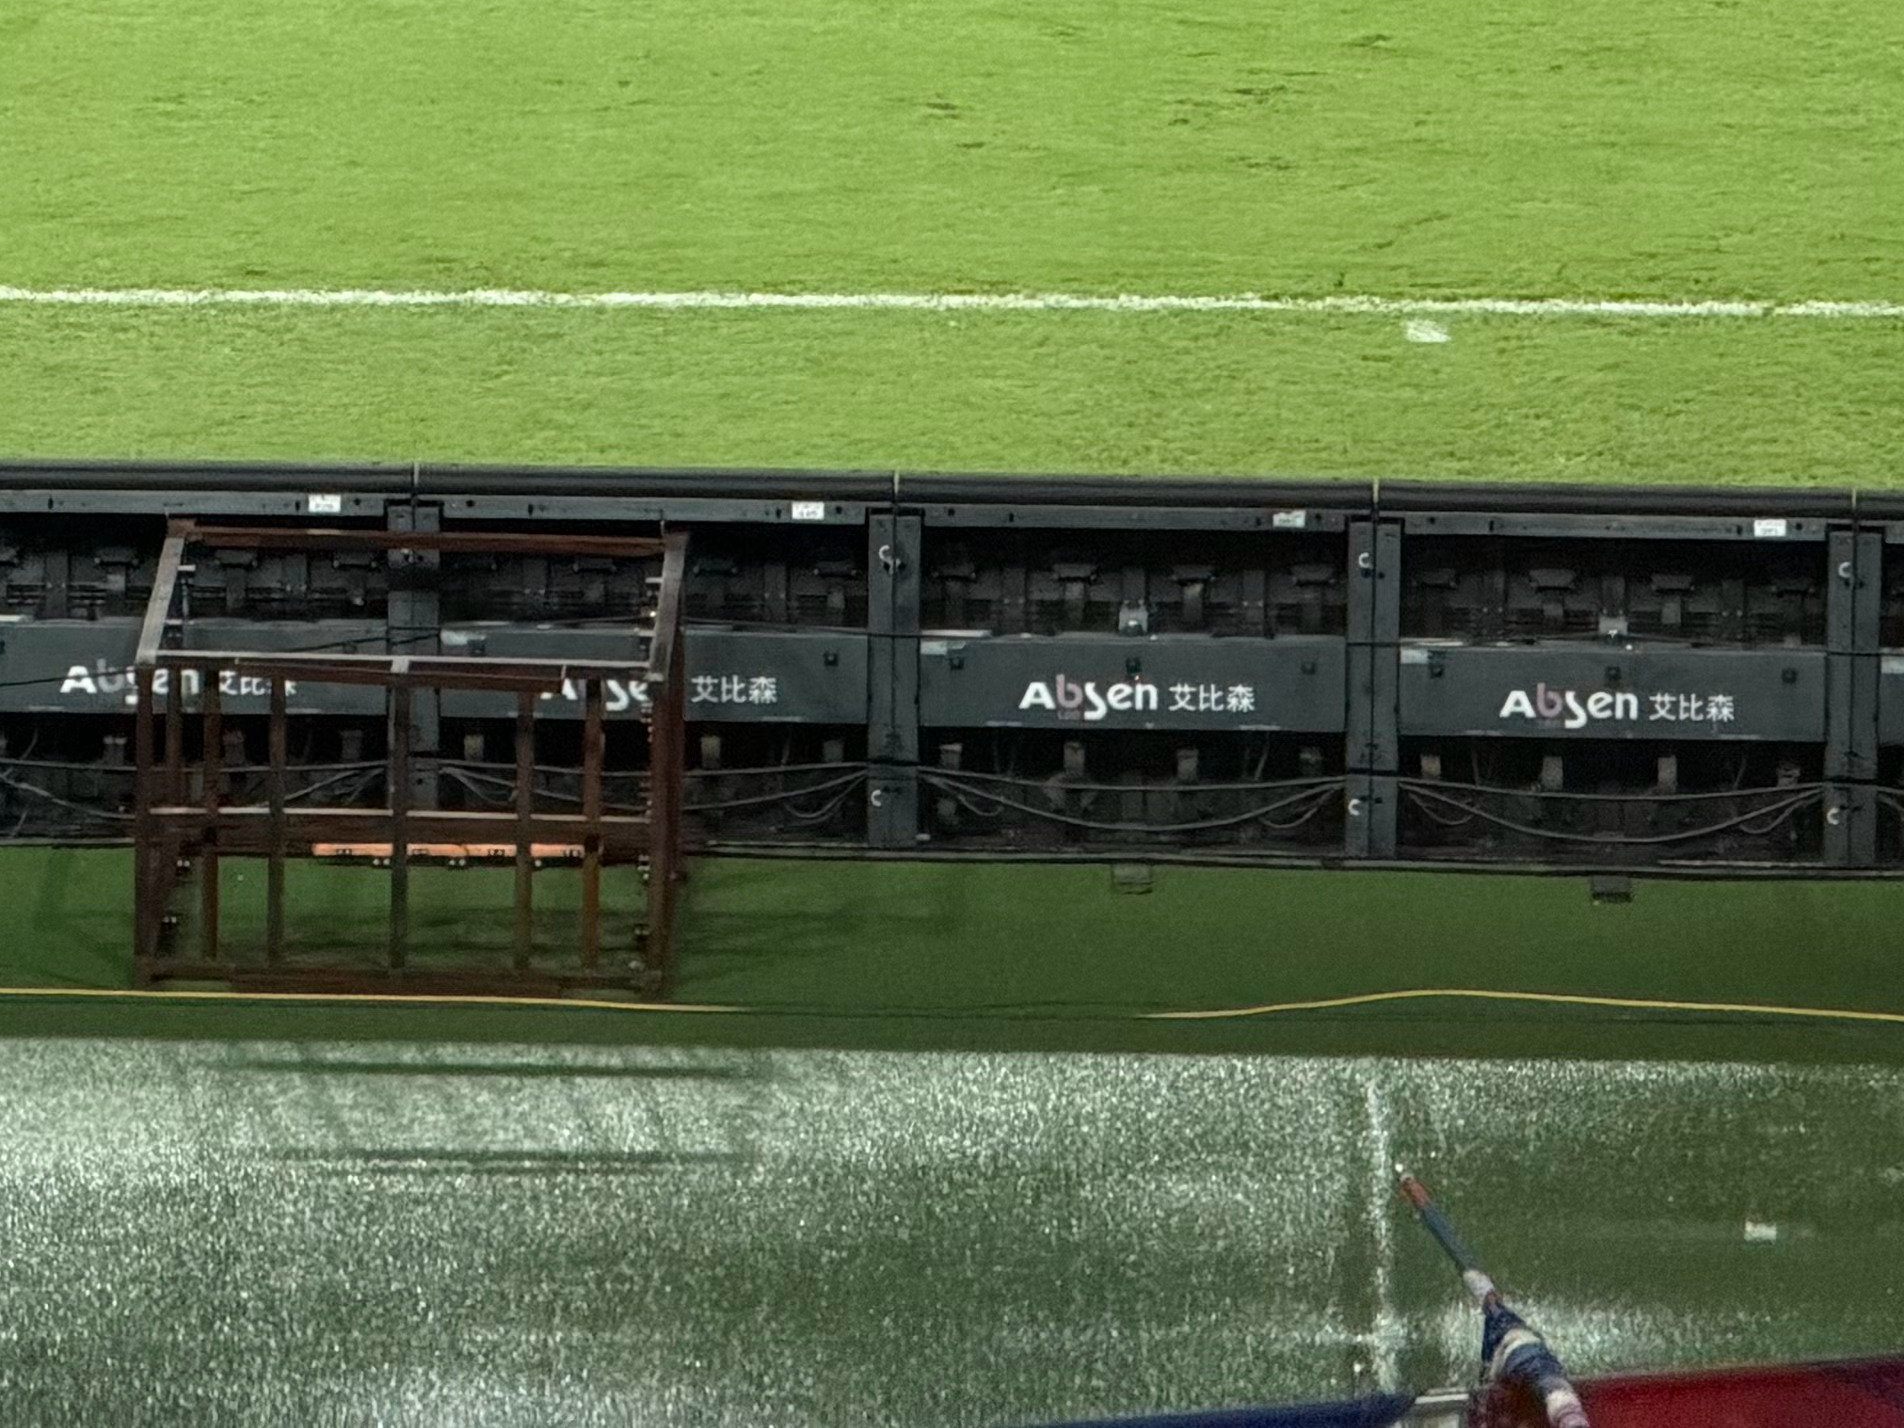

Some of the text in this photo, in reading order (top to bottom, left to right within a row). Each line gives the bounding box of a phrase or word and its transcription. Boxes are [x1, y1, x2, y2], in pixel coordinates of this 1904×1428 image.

[691, 675, 778, 704] 艾比森
[1018, 673, 1256, 720] Absen 艾比森
[1499, 682, 1736, 729] Absen 艾比森
